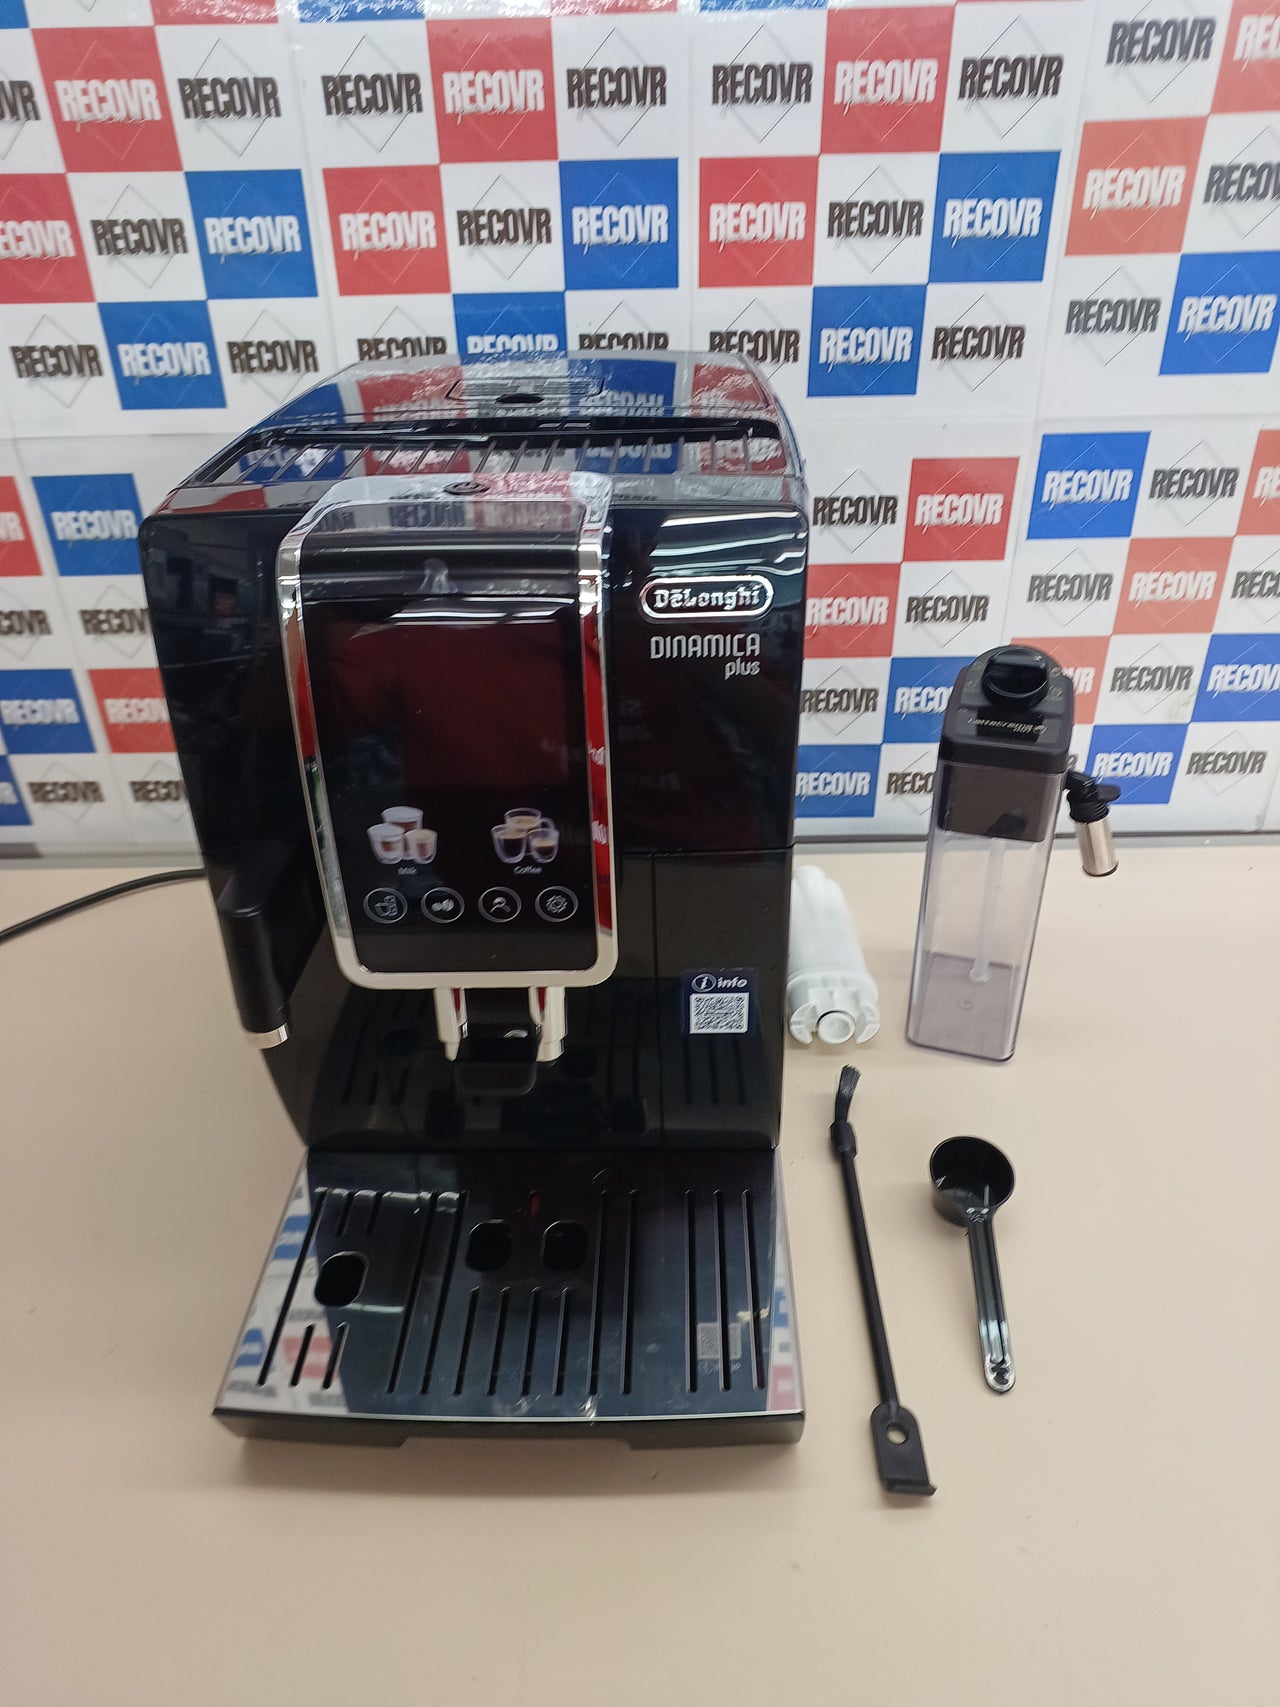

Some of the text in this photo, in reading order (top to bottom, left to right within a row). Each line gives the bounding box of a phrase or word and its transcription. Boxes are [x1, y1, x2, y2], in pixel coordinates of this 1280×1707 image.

[1107, 17, 1216, 65] RECOVR
[321, 73, 422, 115] RECOVR
[443, 69, 544, 113] RECOVR
[567, 65, 667, 107] RECOVR
[712, 63, 812, 105] RECOVR
[834, 58, 938, 103] RECOVR
[958, 55, 1063, 98] RECOVR
[55, 79, 161, 121] RECOVR
[178, 77, 281, 119] RECOVR
[1082, 166, 1186, 209] RECOVR
[205, 215, 301, 253] RECOVR
[339, 211, 437, 250] RECOVR
[457, 208, 551, 246] RECOVR
[572, 204, 668, 244] RECOVR
[709, 201, 806, 241] RECOVR
[828, 201, 924, 238] RECOVR
[943, 197, 1041, 238] RECOVR
[91, 218, 188, 255] RECOVR
[1065, 298, 1161, 335] RECOVR
[1176, 294, 1277, 335] RECOVR
[117, 341, 211, 377] RECOVR
[227, 340, 320, 373] RECOVR
[819, 326, 913, 363] RECOVR
[931, 325, 1025, 361] RECOVR
[10, 345, 103, 378] RECOVR
[1041, 469, 1133, 503] RECOVR
[1150, 467, 1240, 499] RECOVR
[51, 510, 139, 541] RECOVR
[813, 496, 898, 527] RECOVR
[914, 493, 1004, 526] RECOVR
[1028, 575, 1112, 602] RECOVR
[1129, 571, 1217, 602] RECOVR
[805, 596, 889, 627] RECOVR
[905, 595, 990, 624] RECOVR
[650, 633, 761, 659] DINAMICA
[725, 658, 760, 680] plus
[1110, 665, 1194, 695] RECOVR
[1, 699, 81, 724] RECOVR
[802, 687, 879, 714] RECOVR
[1091, 751, 1174, 780] RECOVR
[1186, 750, 1267, 777] RECOVR
[28, 781, 103, 802] RECOVR
[796, 771, 871, 797] RECOVR
[514, 866, 542, 875] Coffee
[717, 976, 748, 988] info
